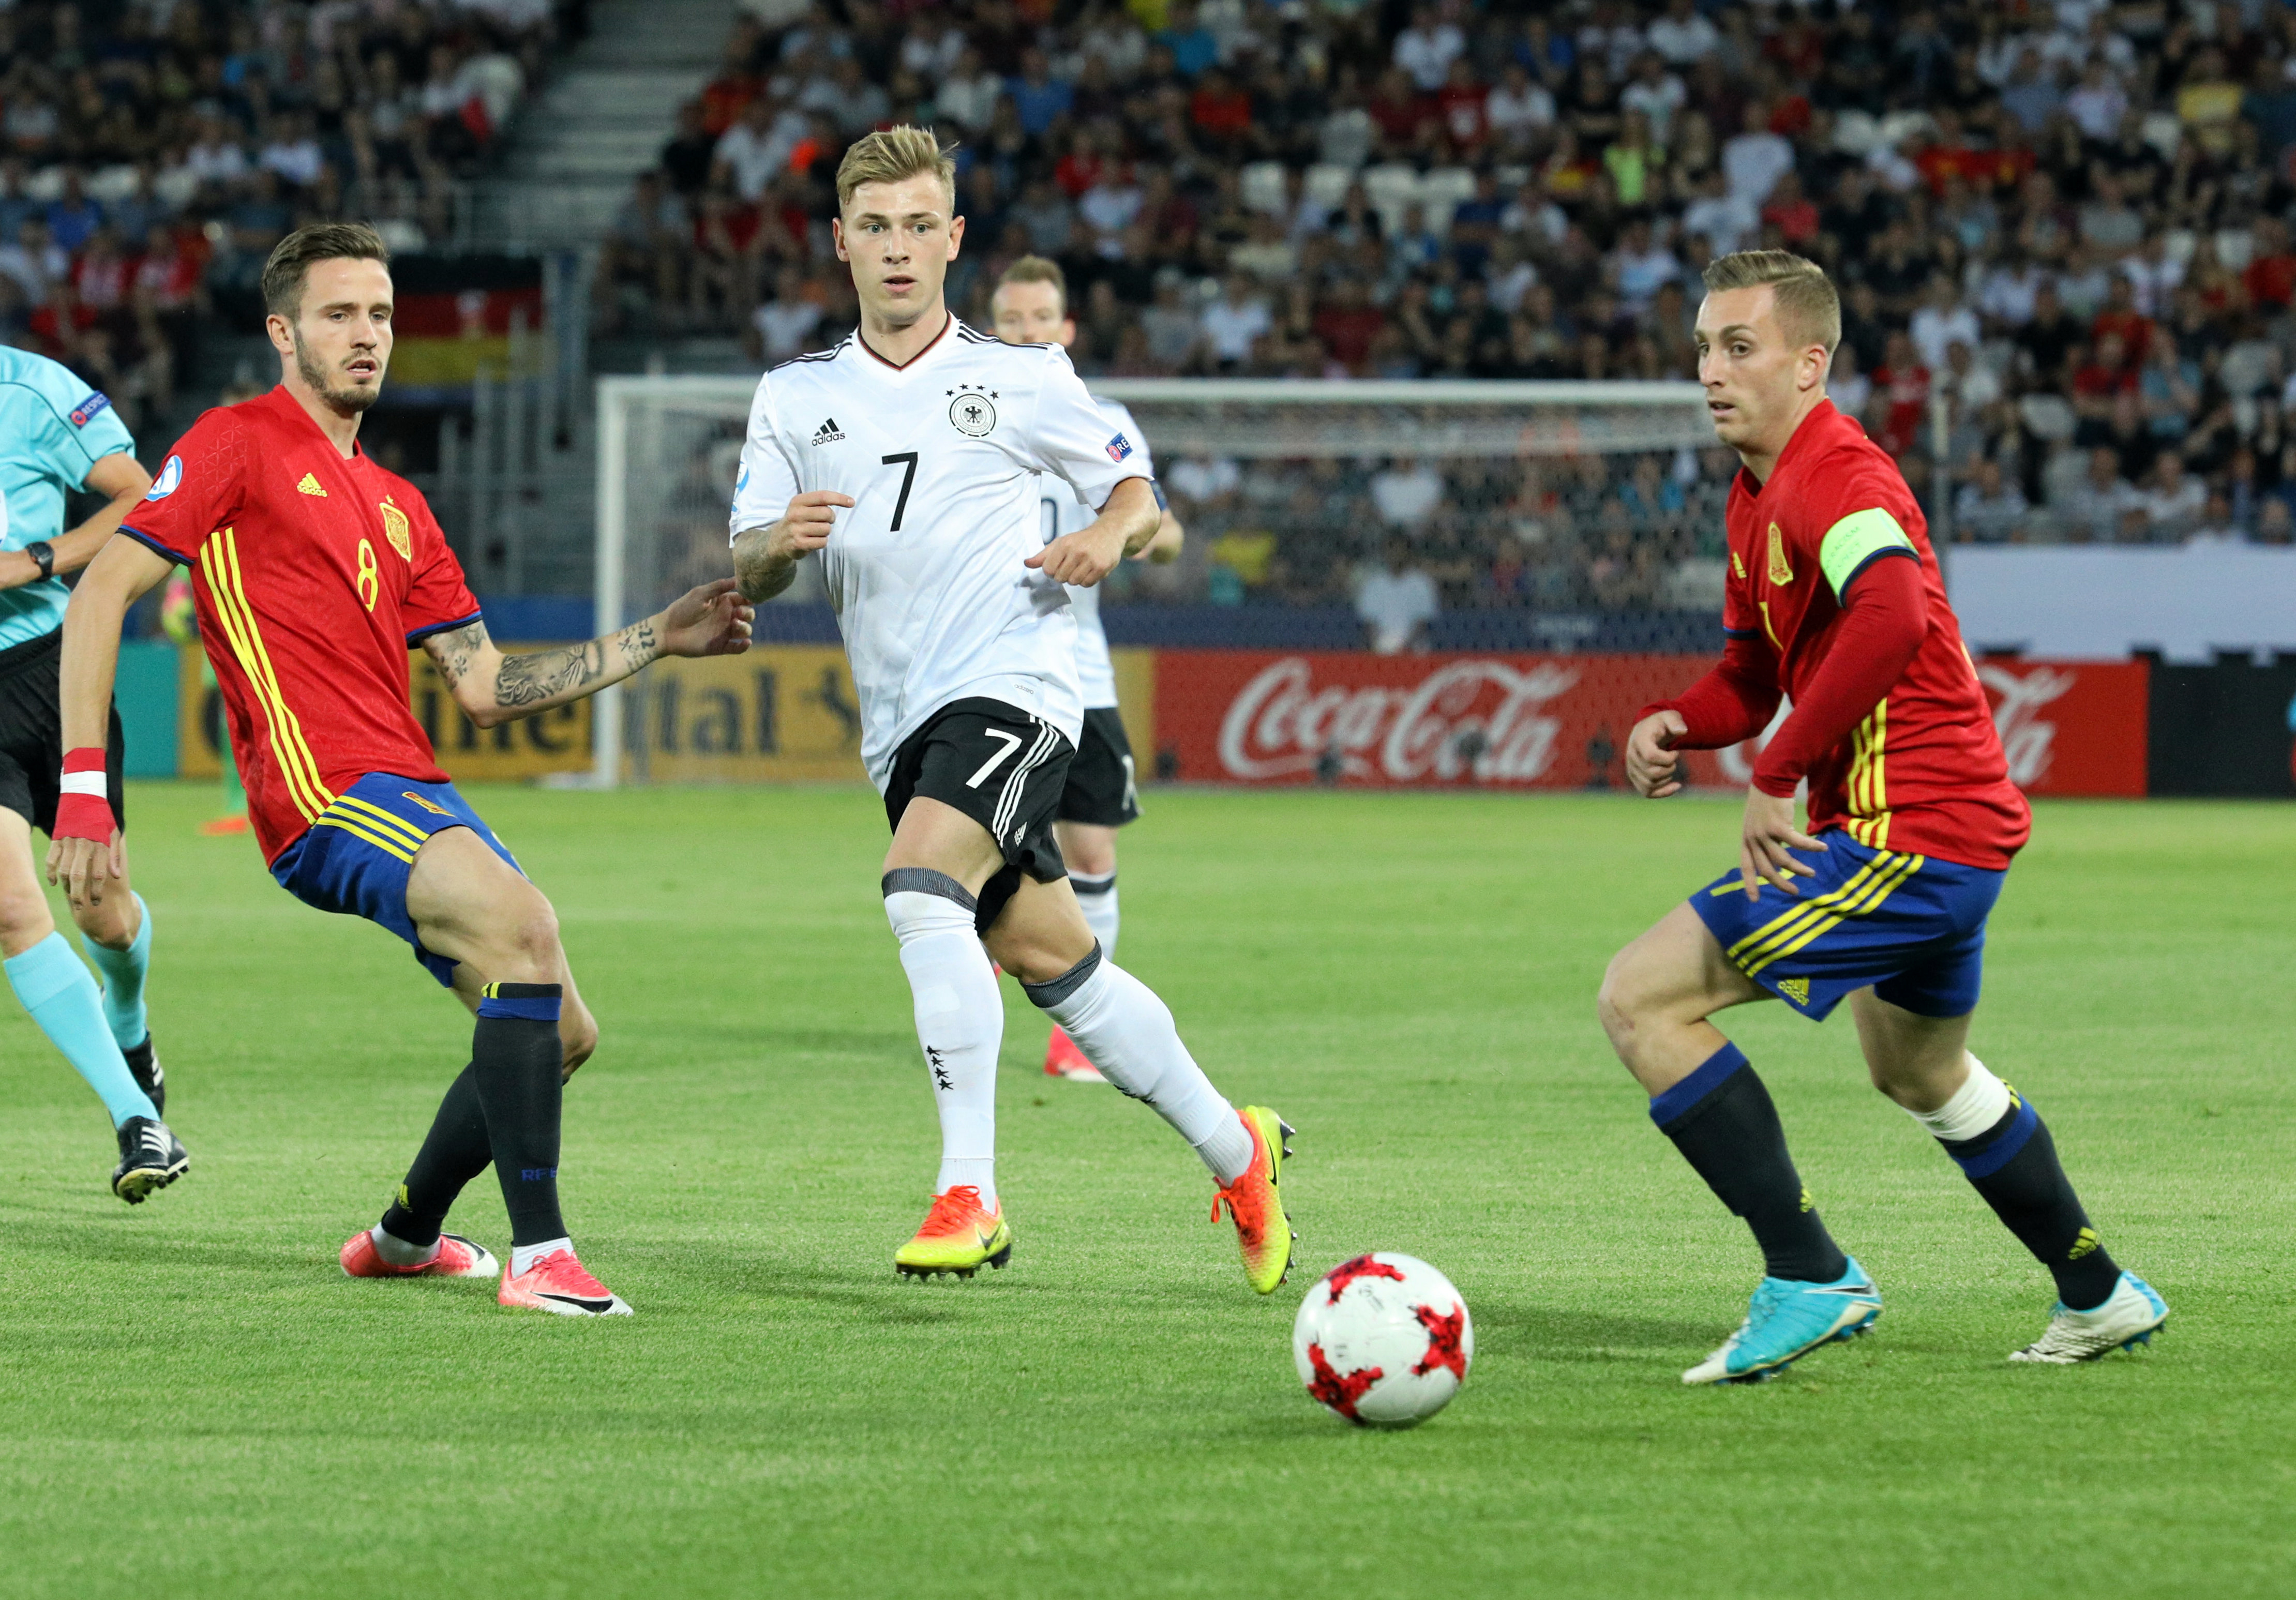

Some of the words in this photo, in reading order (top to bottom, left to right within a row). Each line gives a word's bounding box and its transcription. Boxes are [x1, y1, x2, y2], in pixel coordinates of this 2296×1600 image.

[812, 432, 846, 447] adidas
[296, 485, 328, 497] adidas
[881, 451, 919, 532] 7
[357, 538, 379, 613] 8
[1218, 656, 1583, 781] Coca-Cola
[965, 728, 1023, 789] 7
